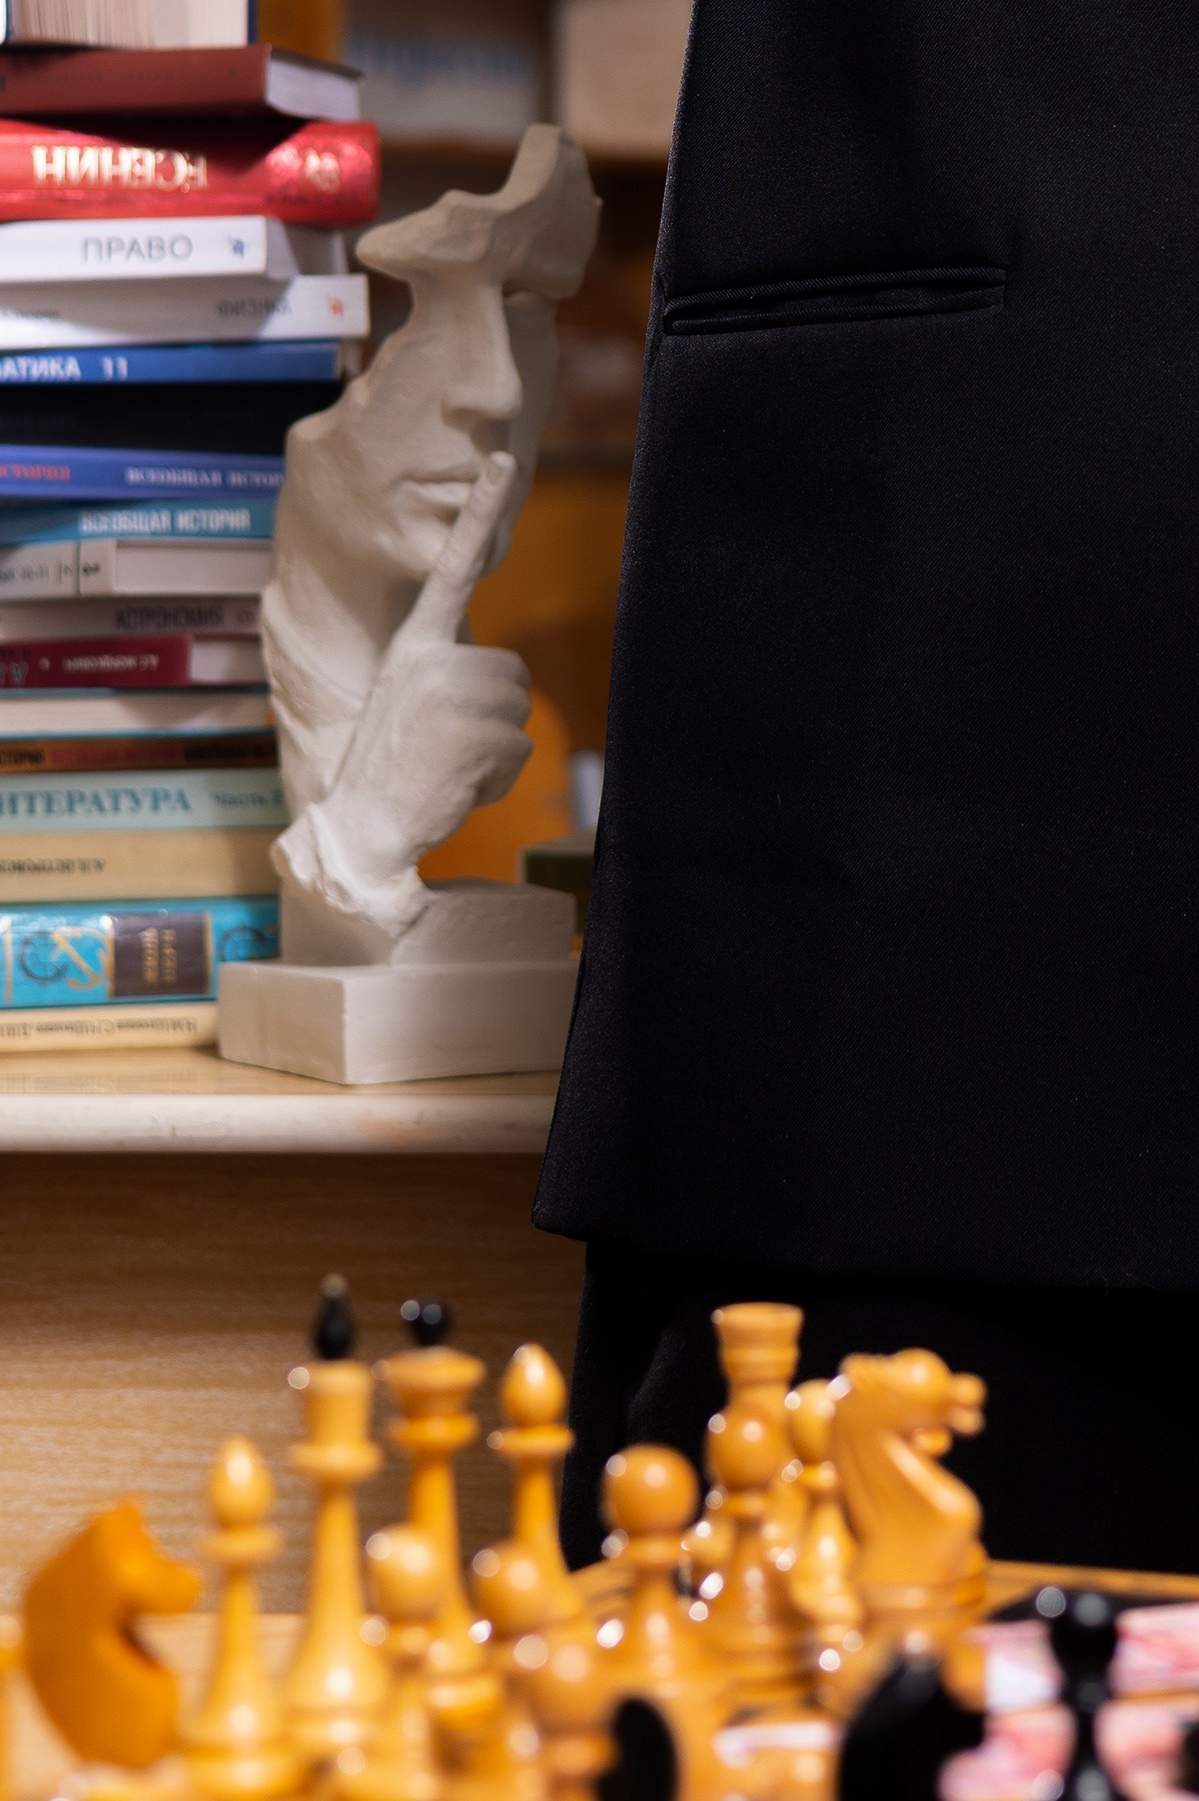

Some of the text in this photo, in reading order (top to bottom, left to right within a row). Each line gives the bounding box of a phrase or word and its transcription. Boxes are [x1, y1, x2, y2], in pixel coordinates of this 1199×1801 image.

[32, 145, 208, 191] ЕСЕНИН
[82, 234, 193, 261] ПРАВО
[0, 356, 128, 381] АТИКА 11
[79, 508, 250, 534] ВСЕОБЩАЯ ИСТОРИЯ
